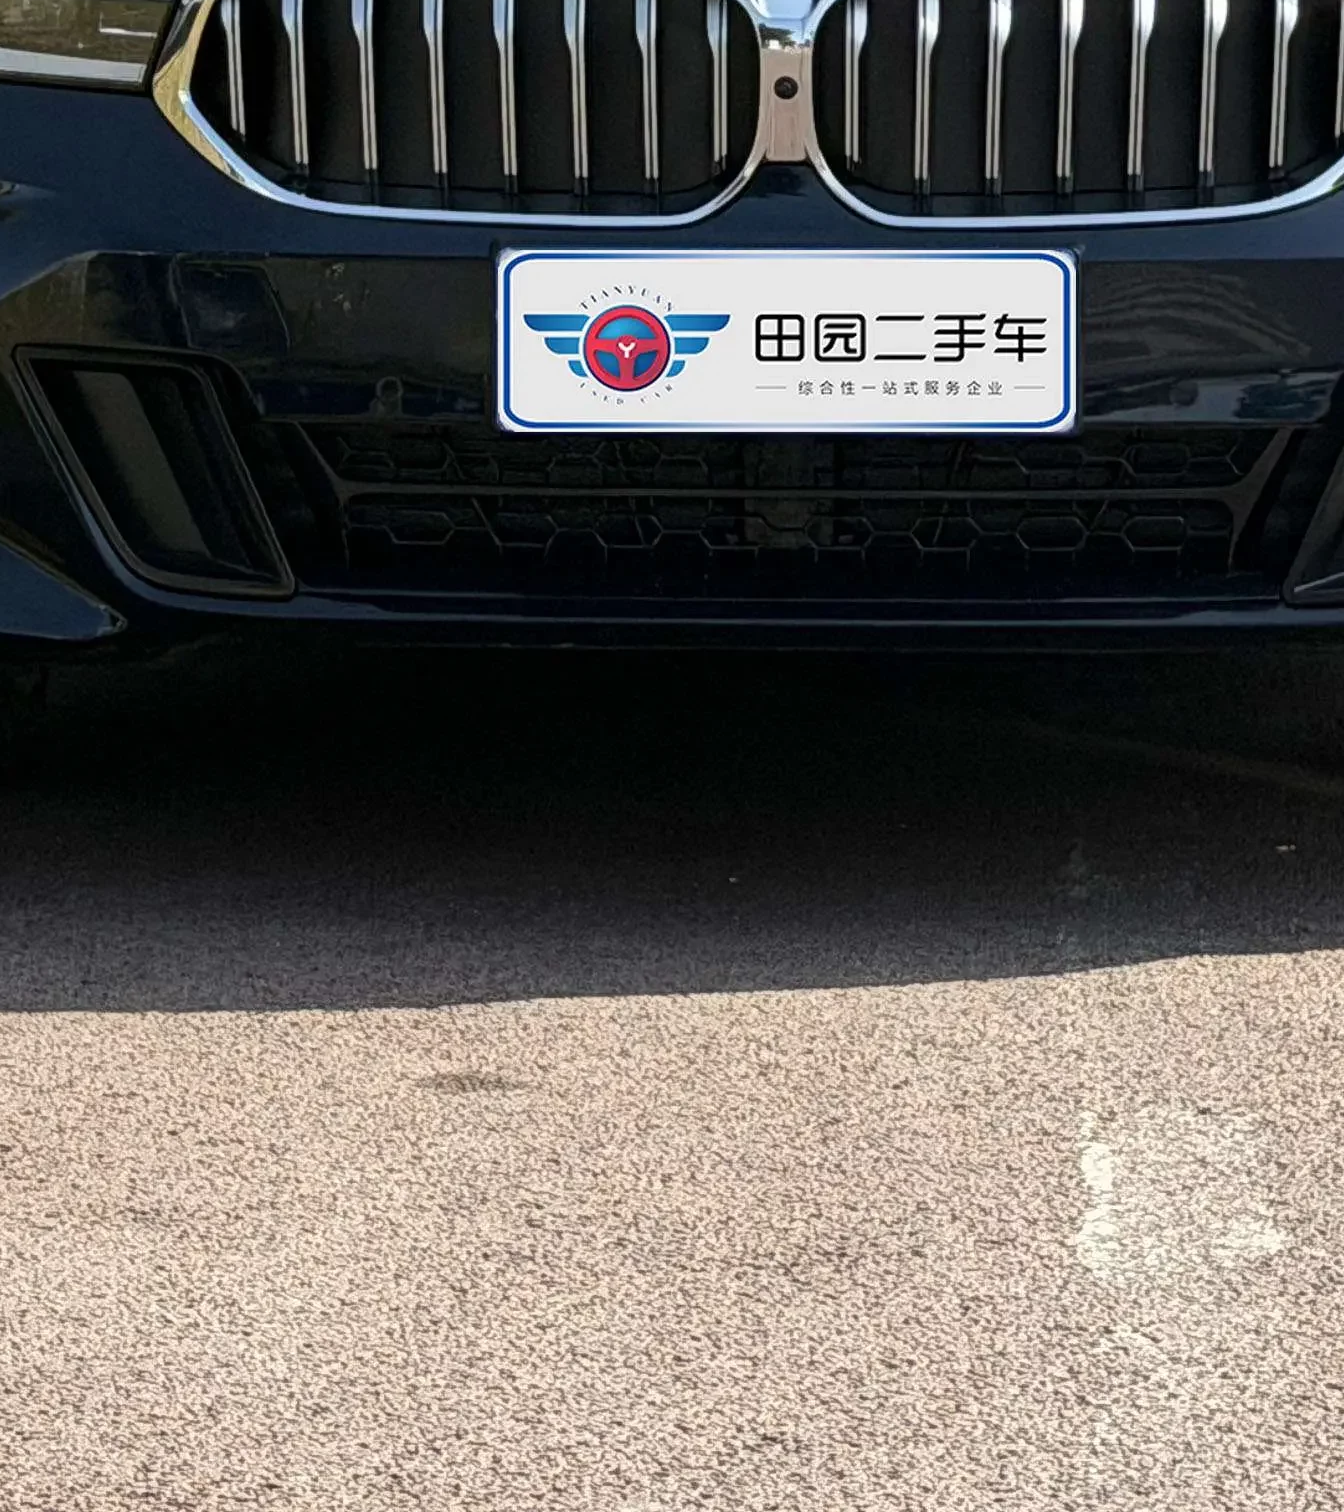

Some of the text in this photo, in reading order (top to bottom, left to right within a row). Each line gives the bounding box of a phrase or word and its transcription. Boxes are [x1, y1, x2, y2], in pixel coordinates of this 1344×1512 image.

[754, 313, 1048, 363] 田园二手车
[798, 379, 1003, 396] 综合性一站式服务企业
